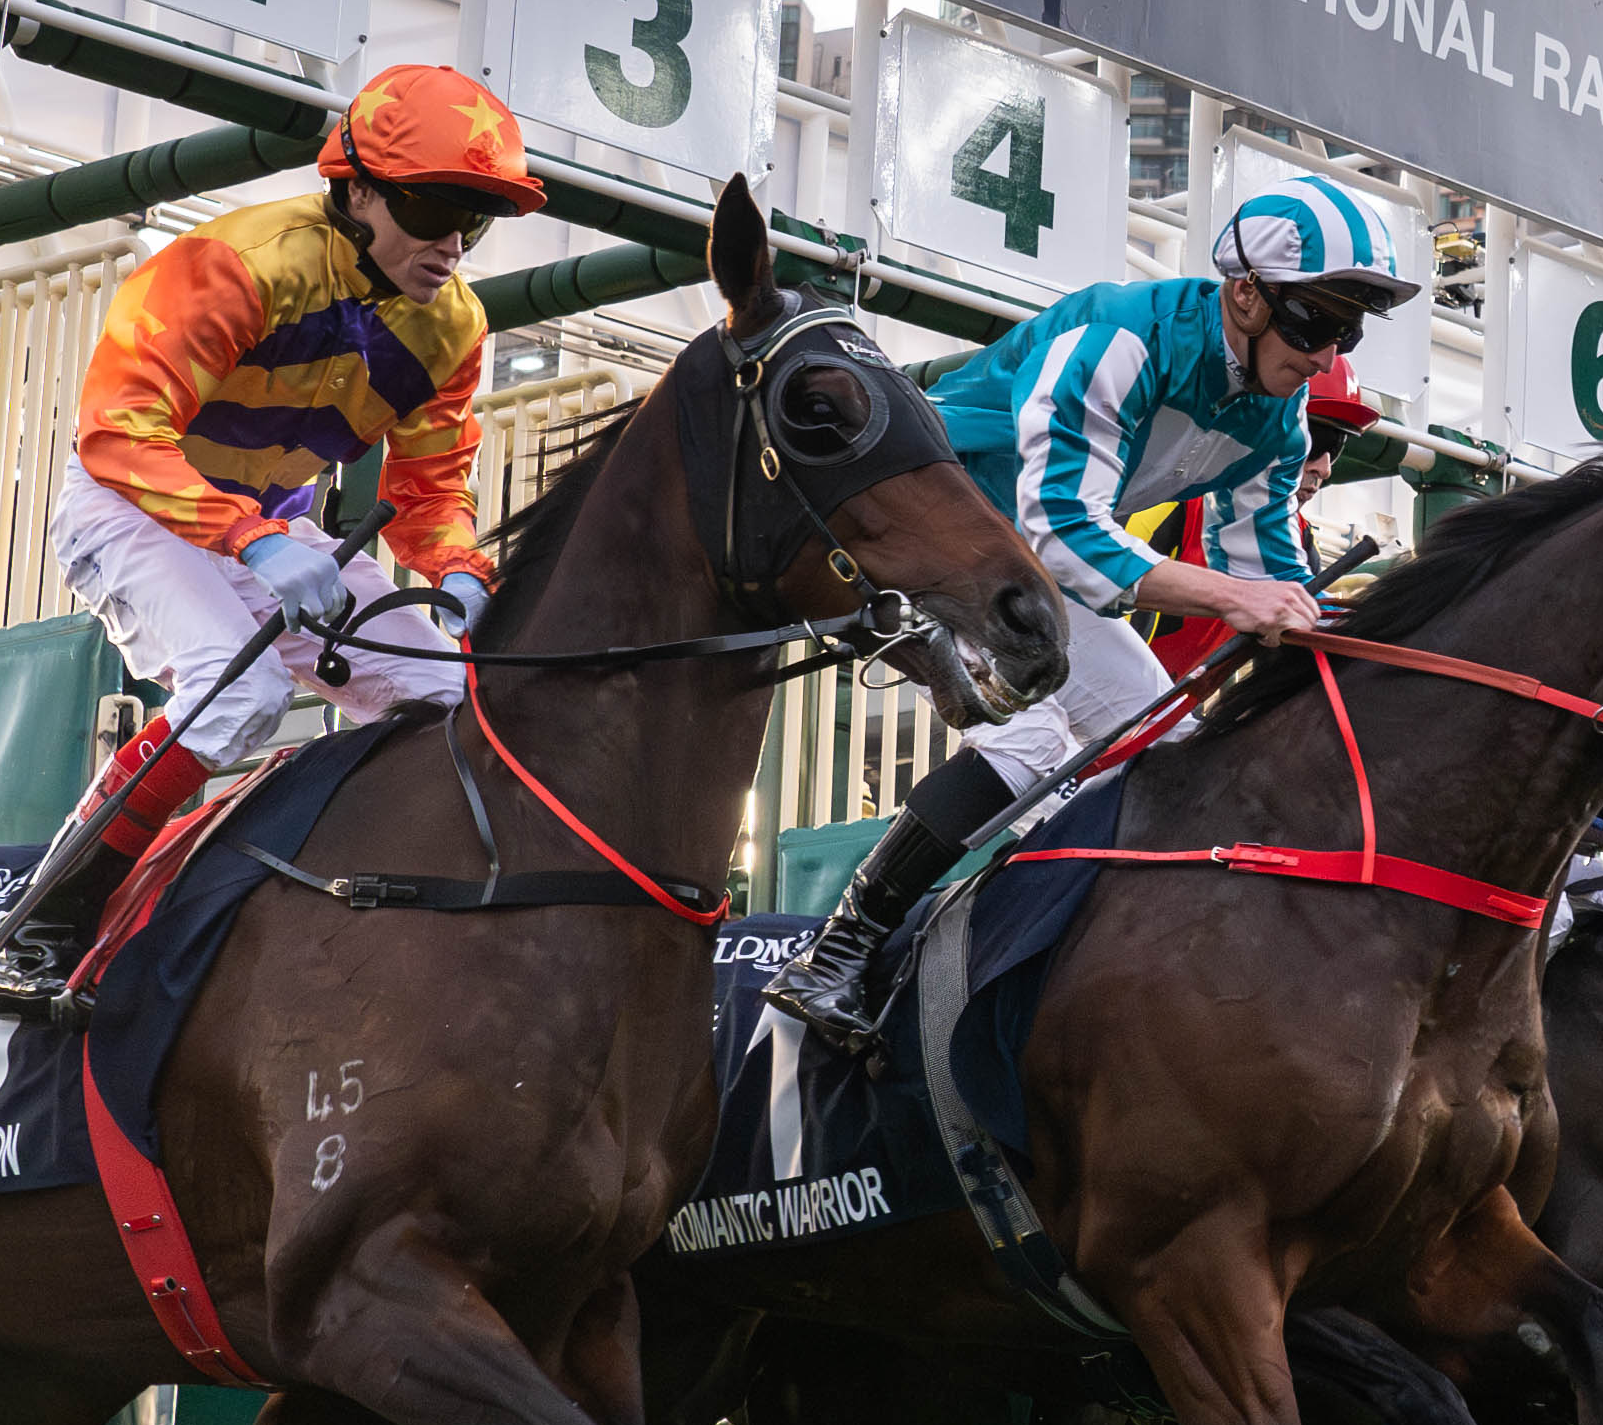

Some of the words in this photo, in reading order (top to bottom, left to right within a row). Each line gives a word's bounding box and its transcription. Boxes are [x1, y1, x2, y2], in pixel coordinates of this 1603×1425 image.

[951, 96, 1056, 259] 4
[746, 1002, 807, 1180] 1
[311, 1134, 346, 1191] 8
[776, 1167, 891, 1238] WARRIOR
